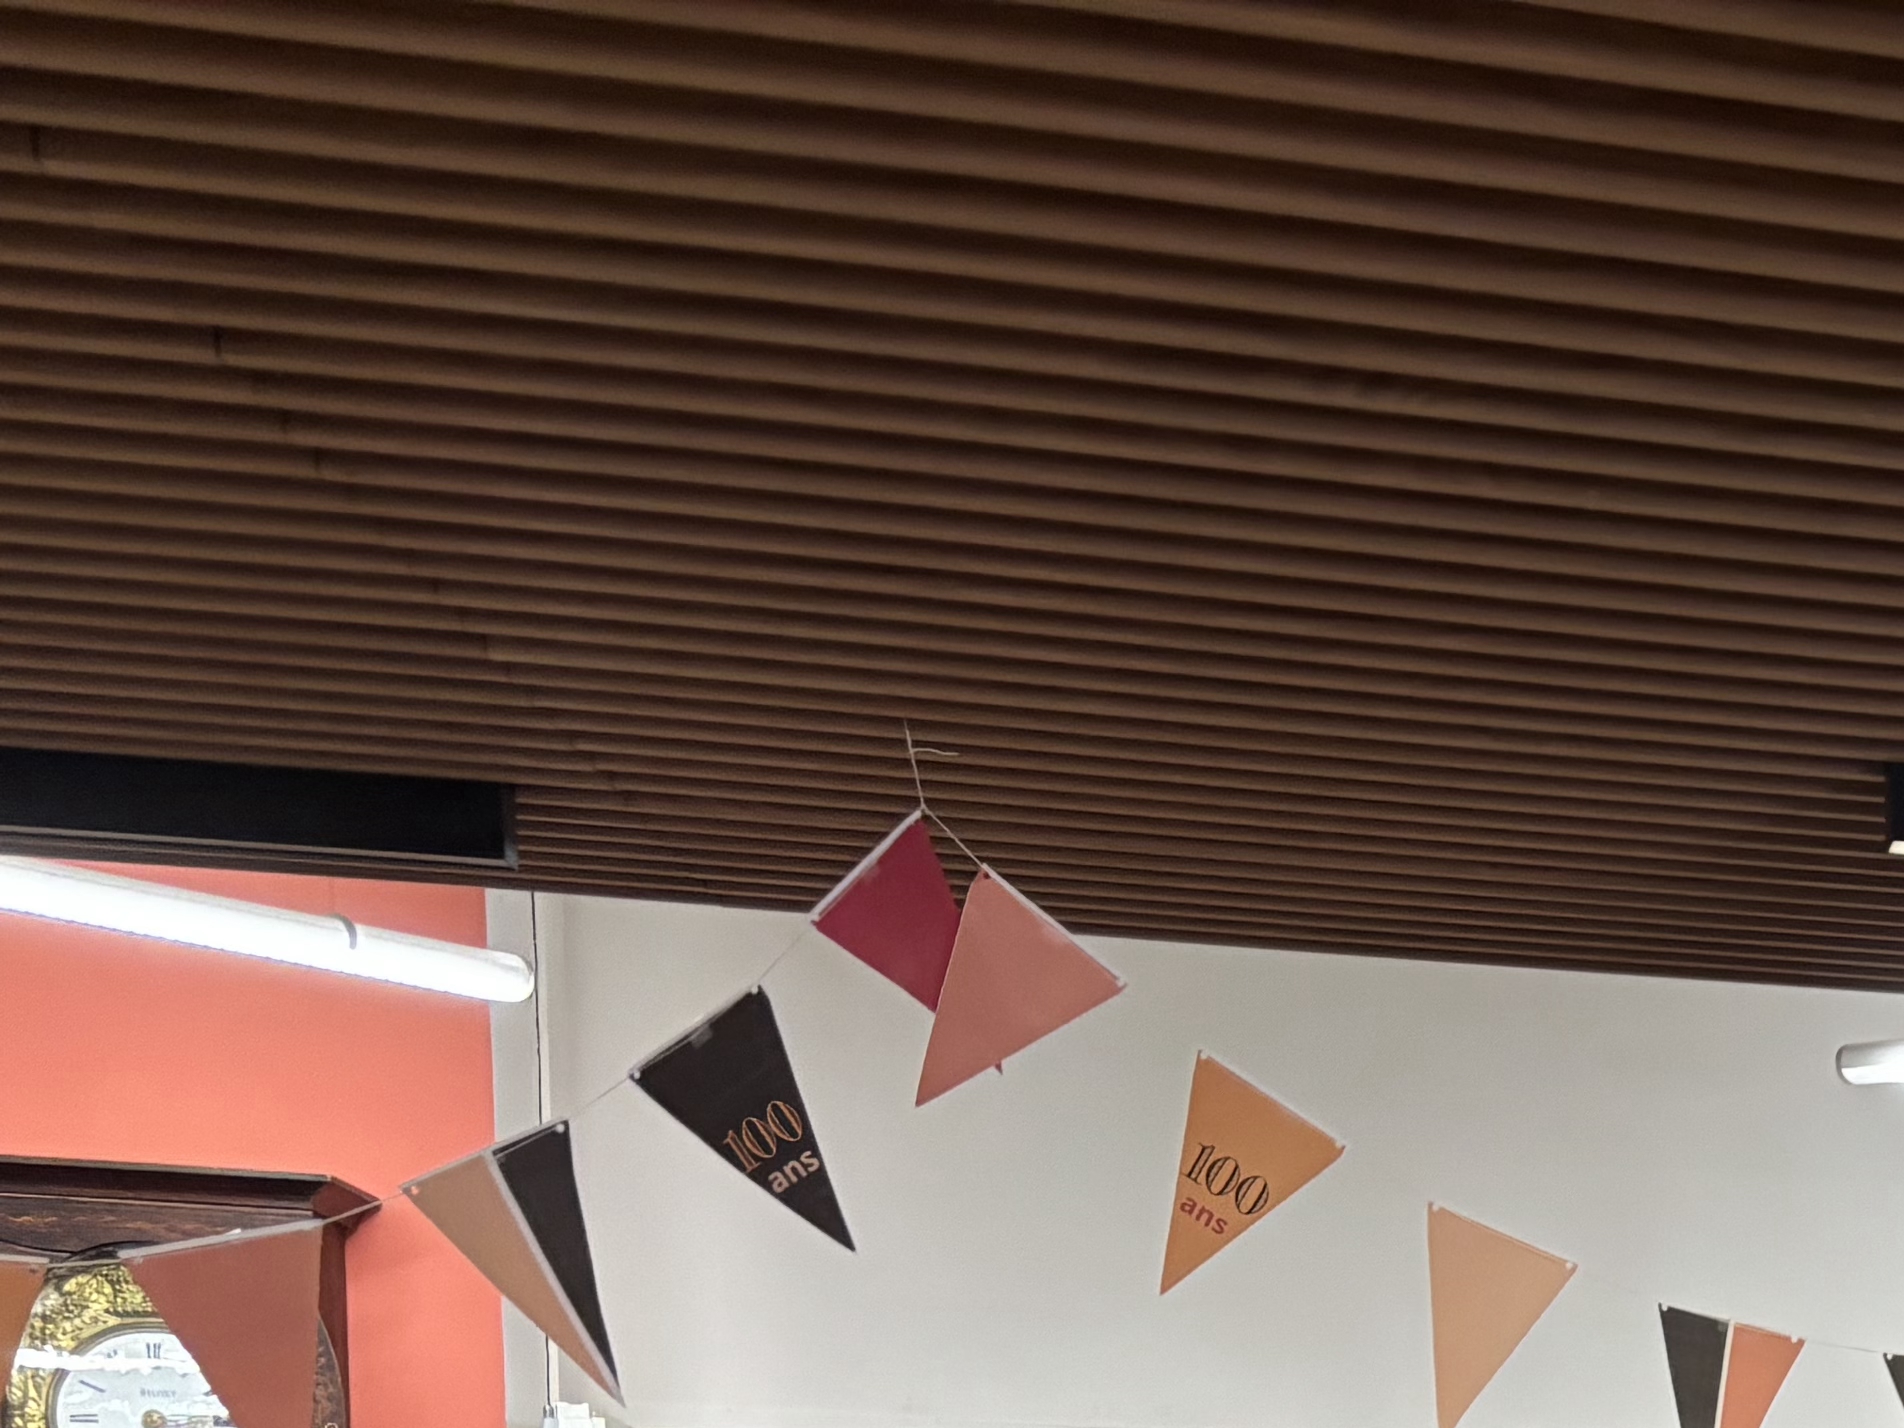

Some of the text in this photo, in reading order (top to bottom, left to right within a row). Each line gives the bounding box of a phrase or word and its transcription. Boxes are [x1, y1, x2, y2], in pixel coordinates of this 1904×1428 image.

[723, 1101, 802, 1173] 100
[768, 1150, 820, 1193] ans
[1180, 1142, 1269, 1215] 100
[1180, 1197, 1228, 1234] ans
